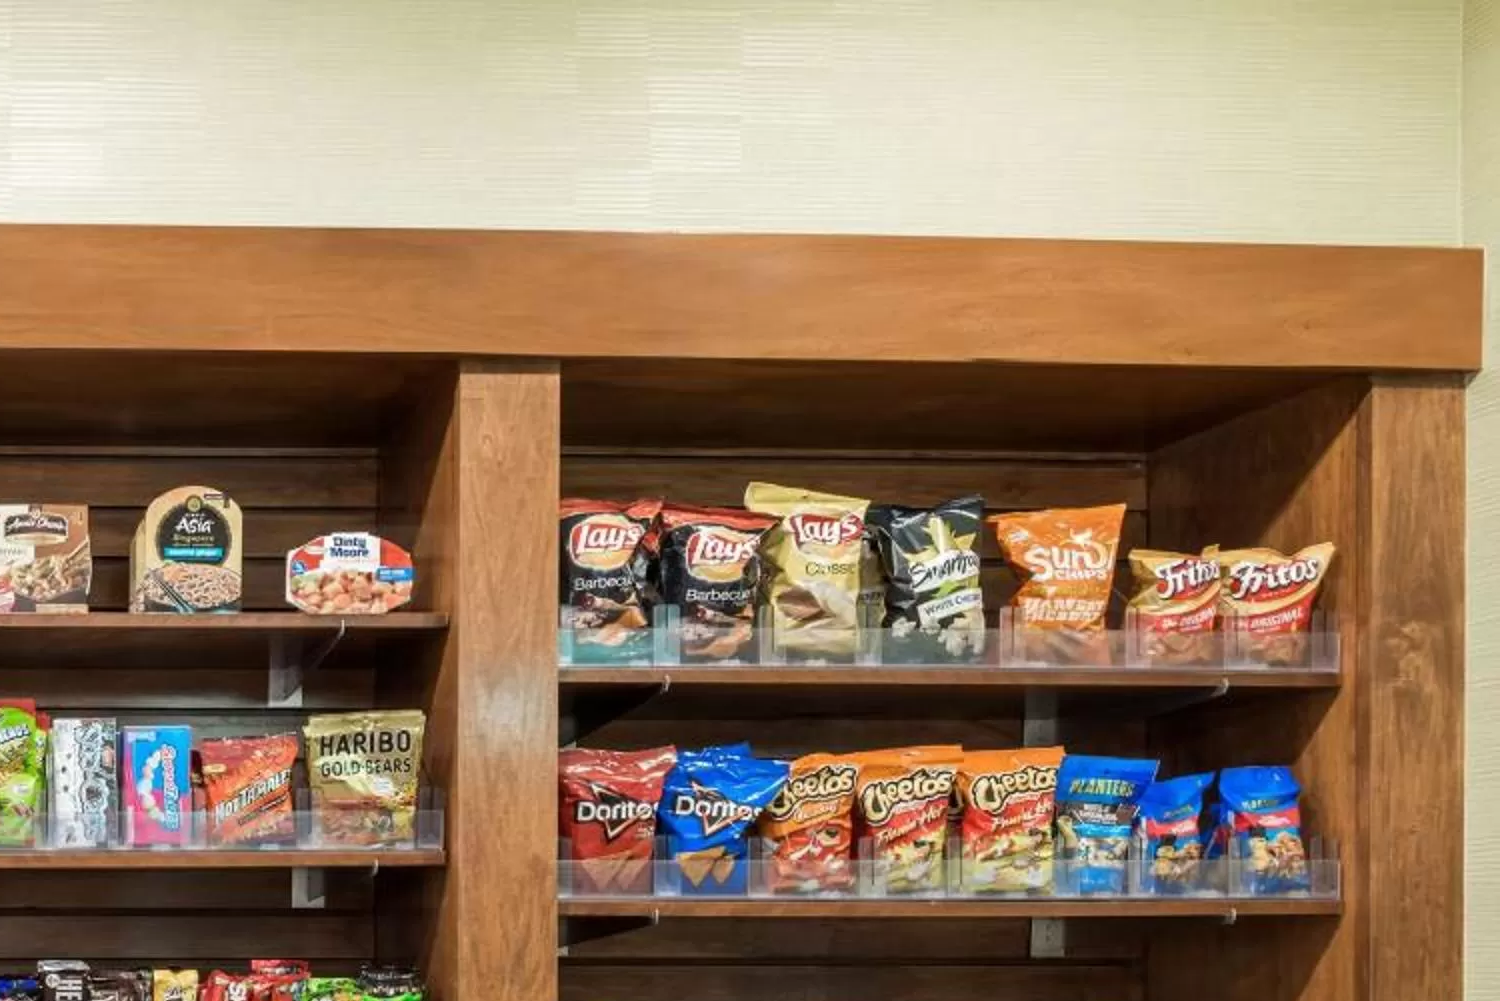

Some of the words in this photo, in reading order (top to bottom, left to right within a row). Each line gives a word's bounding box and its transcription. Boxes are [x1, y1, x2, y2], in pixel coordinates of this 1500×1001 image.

[174, 517, 214, 534] Asia
[332, 536, 367, 548] Dinty
[329, 548, 370, 559] Moore
[1230, 559, 1319, 600] Fritos
[320, 729, 412, 757] HARIBO
[863, 769, 954, 823] Cheetos
